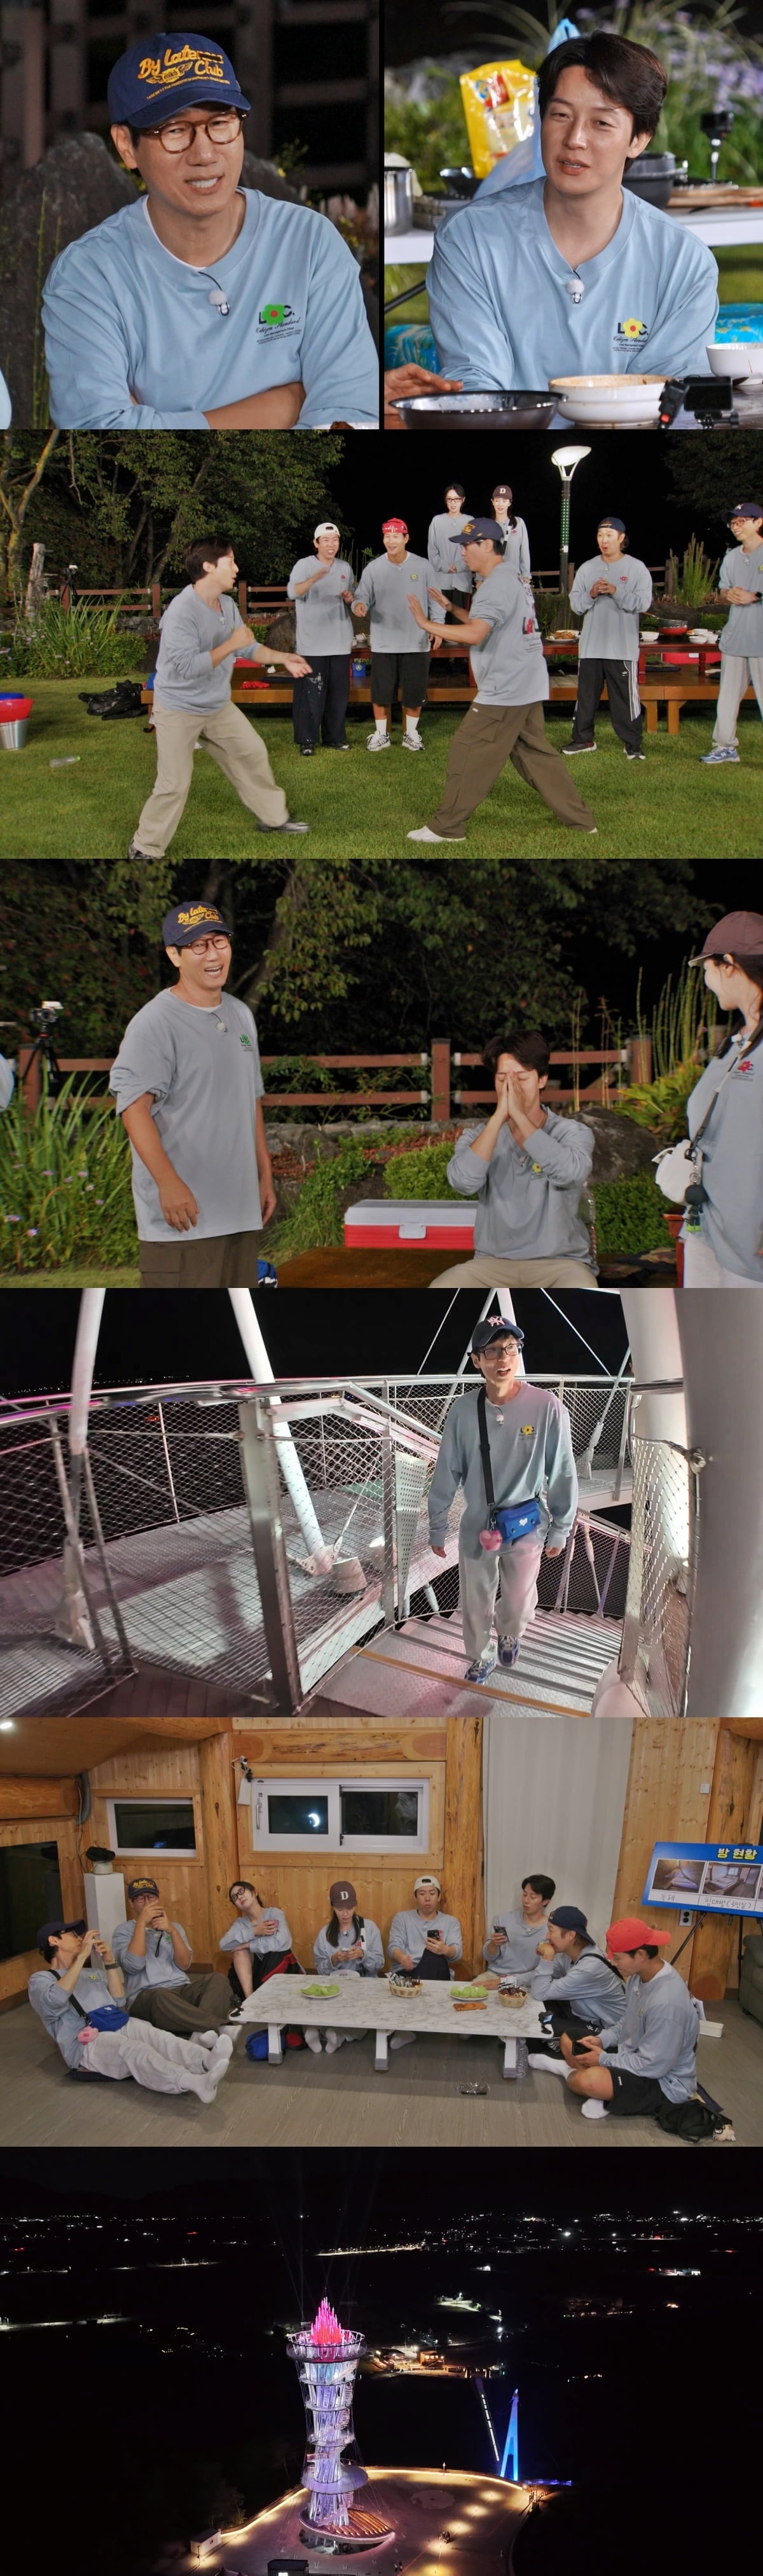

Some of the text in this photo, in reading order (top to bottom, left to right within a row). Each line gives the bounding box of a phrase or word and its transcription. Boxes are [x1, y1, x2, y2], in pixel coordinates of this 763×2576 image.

[137, 58, 161, 79] By
[195, 59, 223, 77] Club
[717, 1848, 757, 1860] 방 현황
[340, 1891, 349, 1901] D
